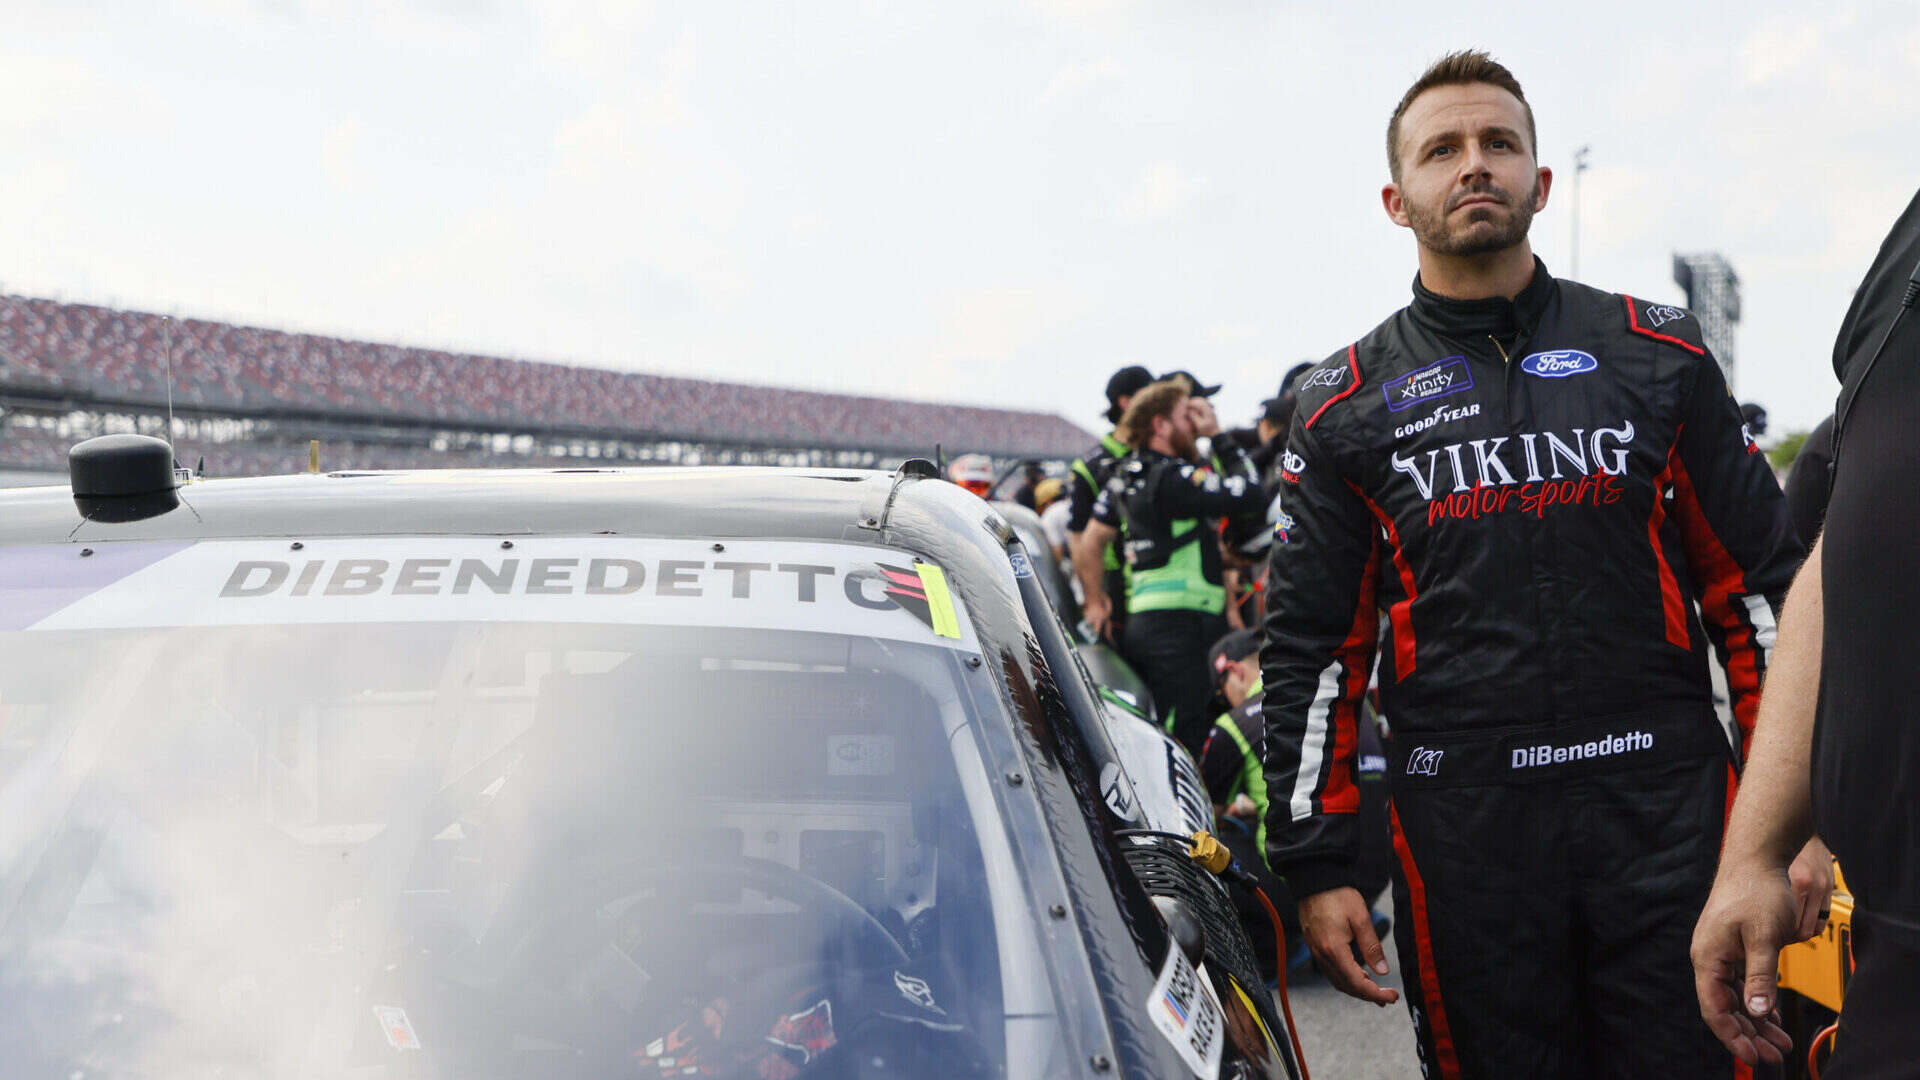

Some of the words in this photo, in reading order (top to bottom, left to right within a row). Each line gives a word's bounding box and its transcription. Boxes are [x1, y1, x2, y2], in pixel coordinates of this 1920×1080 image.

[1535, 352, 1583, 374] Ford
[1401, 371, 1454, 399] xfinity
[1394, 403, 1480, 439] GOODYEAR
[1391, 420, 1635, 500] VIKING
[1427, 465, 1625, 528] motorsports
[219, 558, 901, 611] DIBENEDETTO
[1406, 746, 1444, 777] K1
[1511, 730, 1655, 769] DiBenedetto
